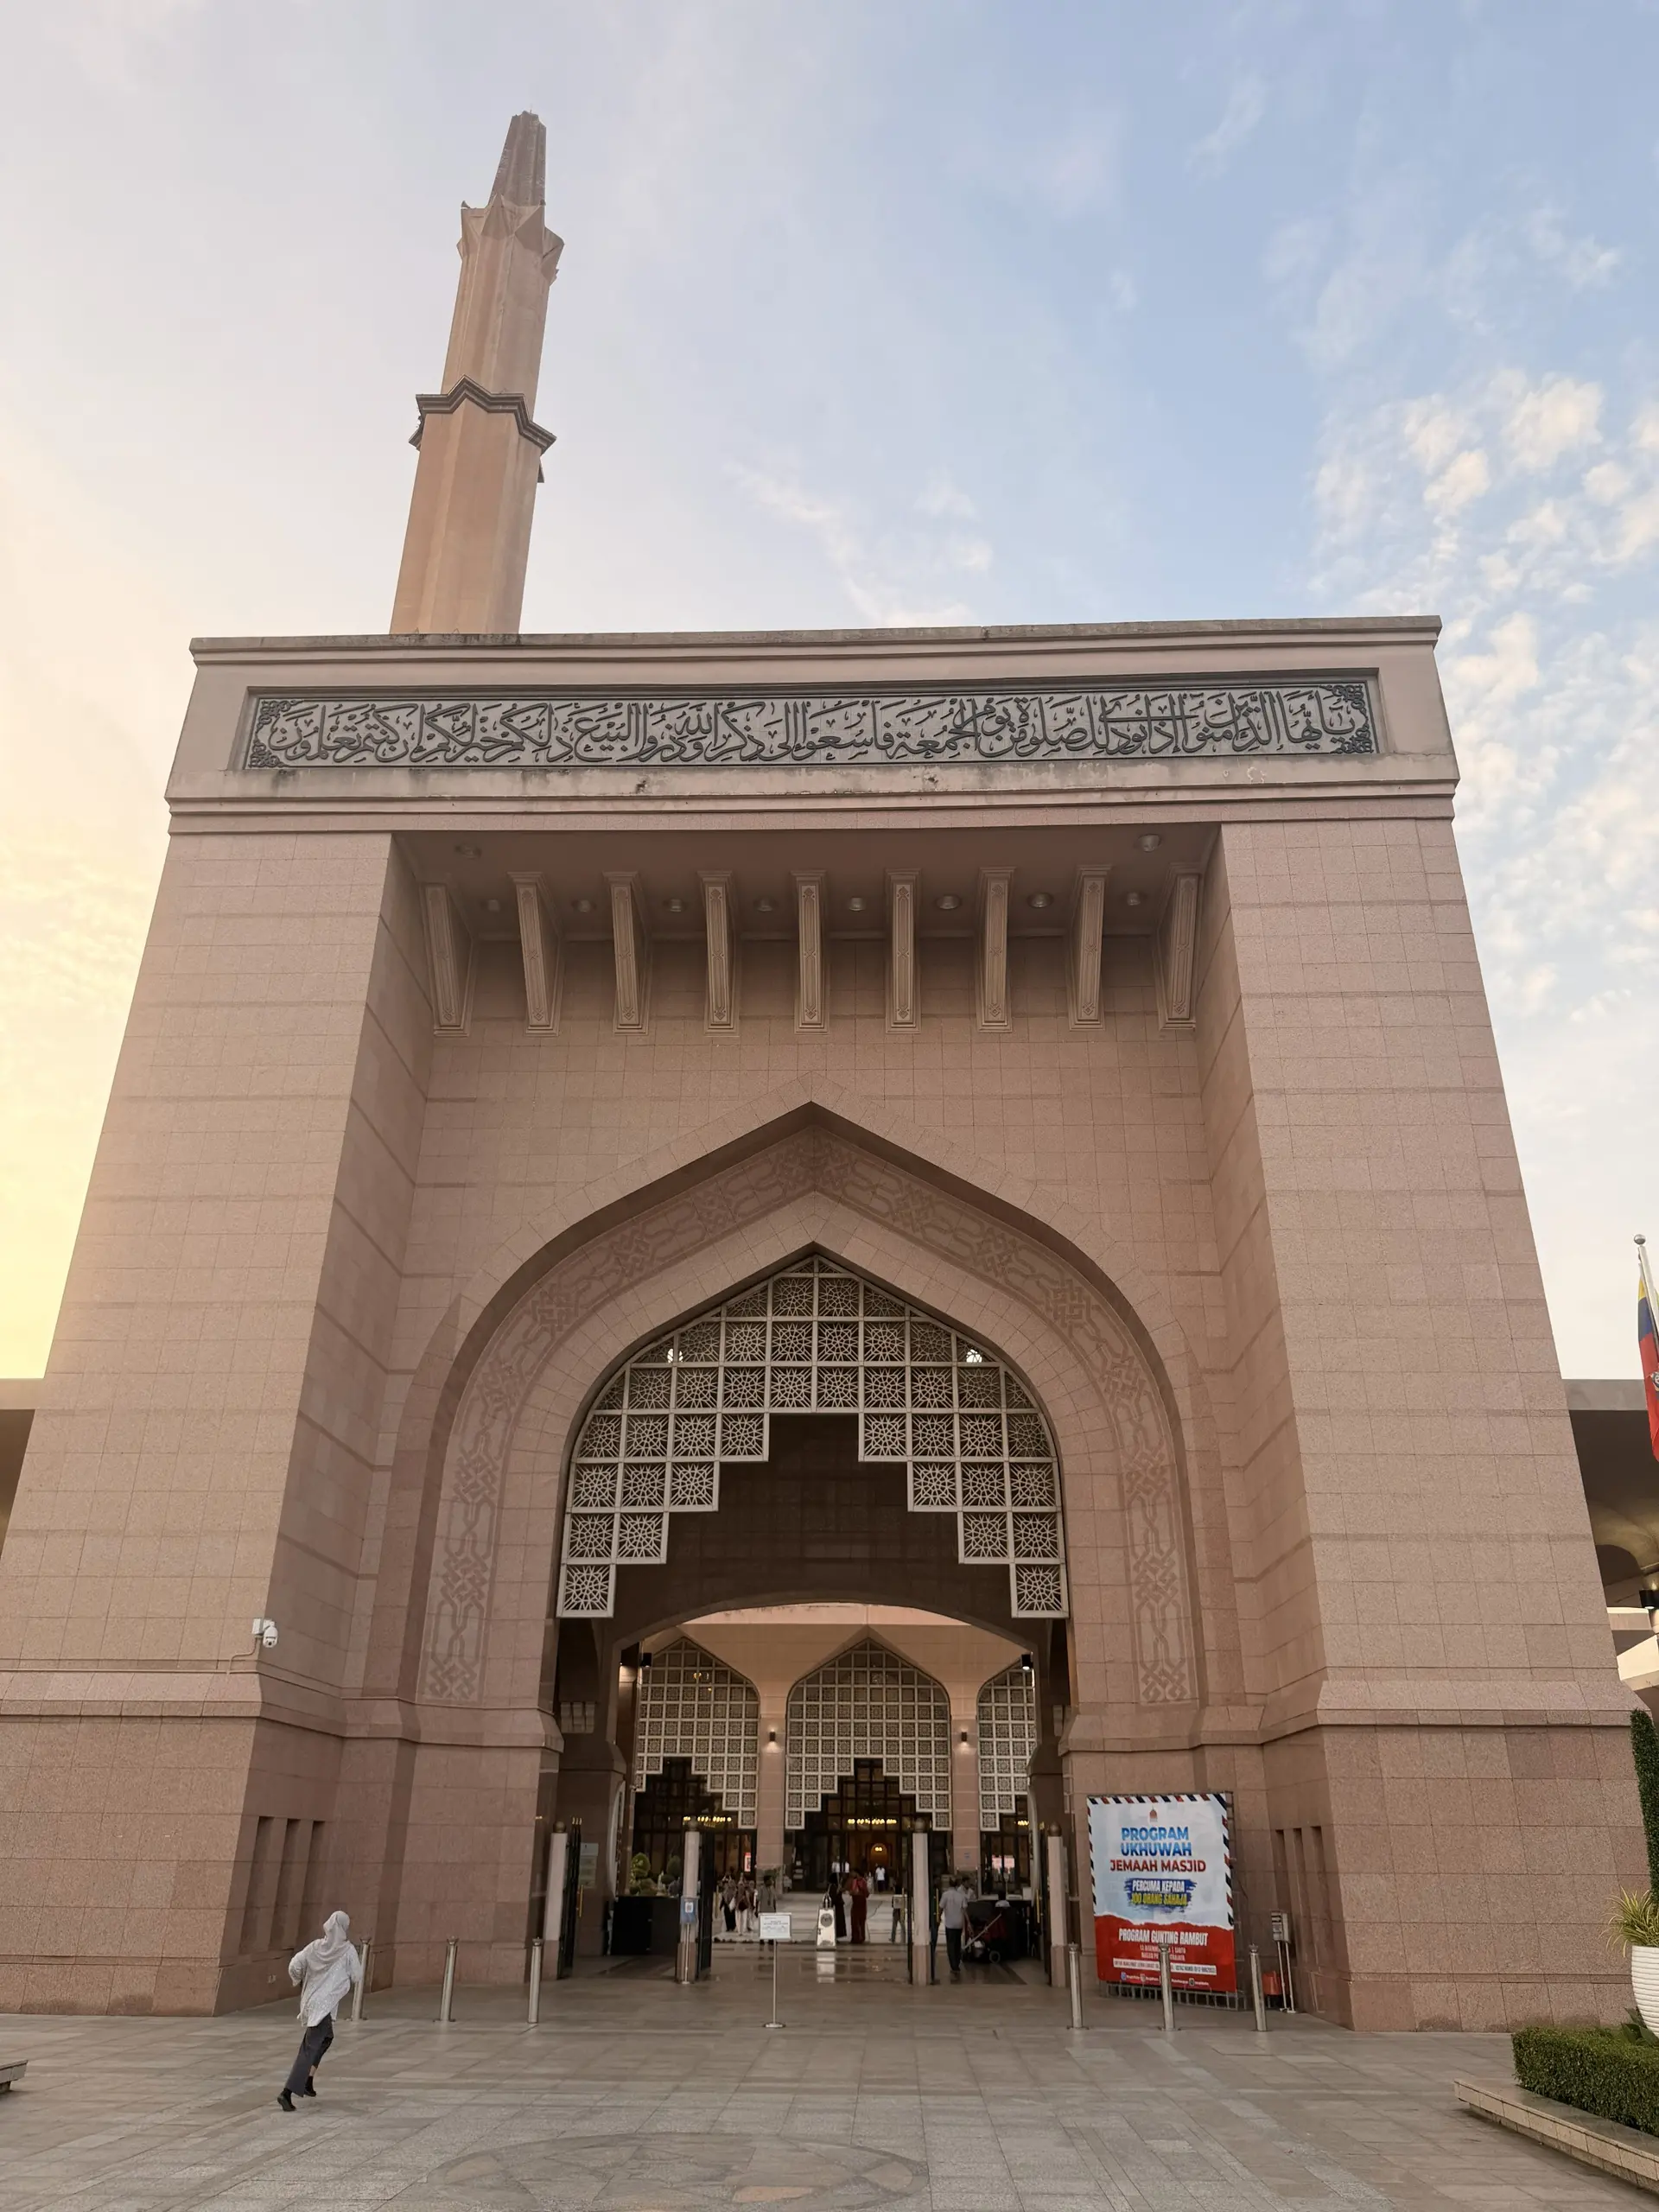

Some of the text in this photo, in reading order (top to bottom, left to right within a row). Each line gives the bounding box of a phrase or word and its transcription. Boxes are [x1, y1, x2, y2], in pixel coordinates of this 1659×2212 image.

[1121, 1827, 1189, 1841] PROGRAM
[1121, 1842, 1192, 1857] UKHUWAH
[1109, 1859, 1207, 1872] JEMAAH MASJID
[1132, 1879, 1185, 1893] PERCUMA KEPADA
[1119, 1928, 1208, 1946] PROGRAM GUNTING RAMBUT
